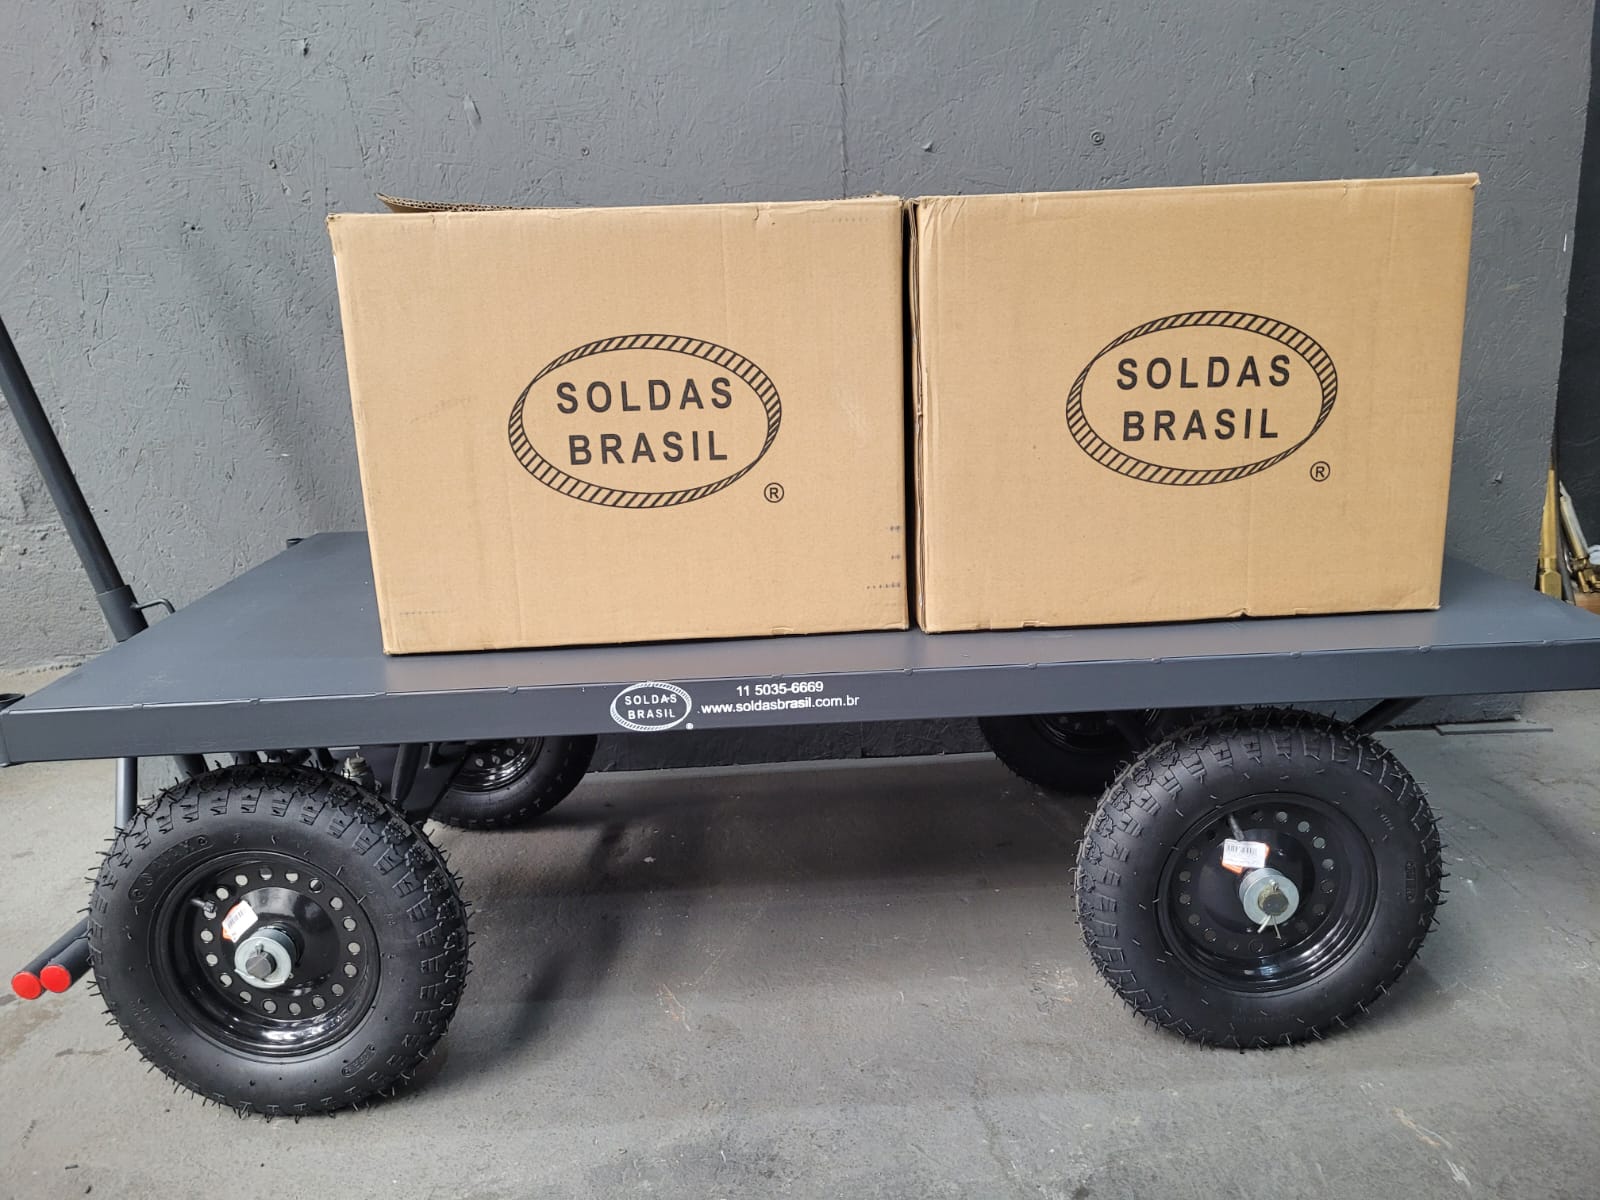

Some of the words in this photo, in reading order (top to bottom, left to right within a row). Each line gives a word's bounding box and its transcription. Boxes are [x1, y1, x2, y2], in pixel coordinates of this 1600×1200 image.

[1117, 354, 1292, 390] SOLDAS
[557, 377, 734, 413] SOLDAS
[1123, 408, 1278, 441] BRASIL
[569, 430, 727, 465] BRASIL
[624, 693, 678, 706] SOLDAS
[736, 685, 750, 697] 11
[754, 681, 824, 696] 5035-6669
[627, 708, 676, 720] BRASIL
[701, 694, 860, 714] www.soldasbrasil.com.br
